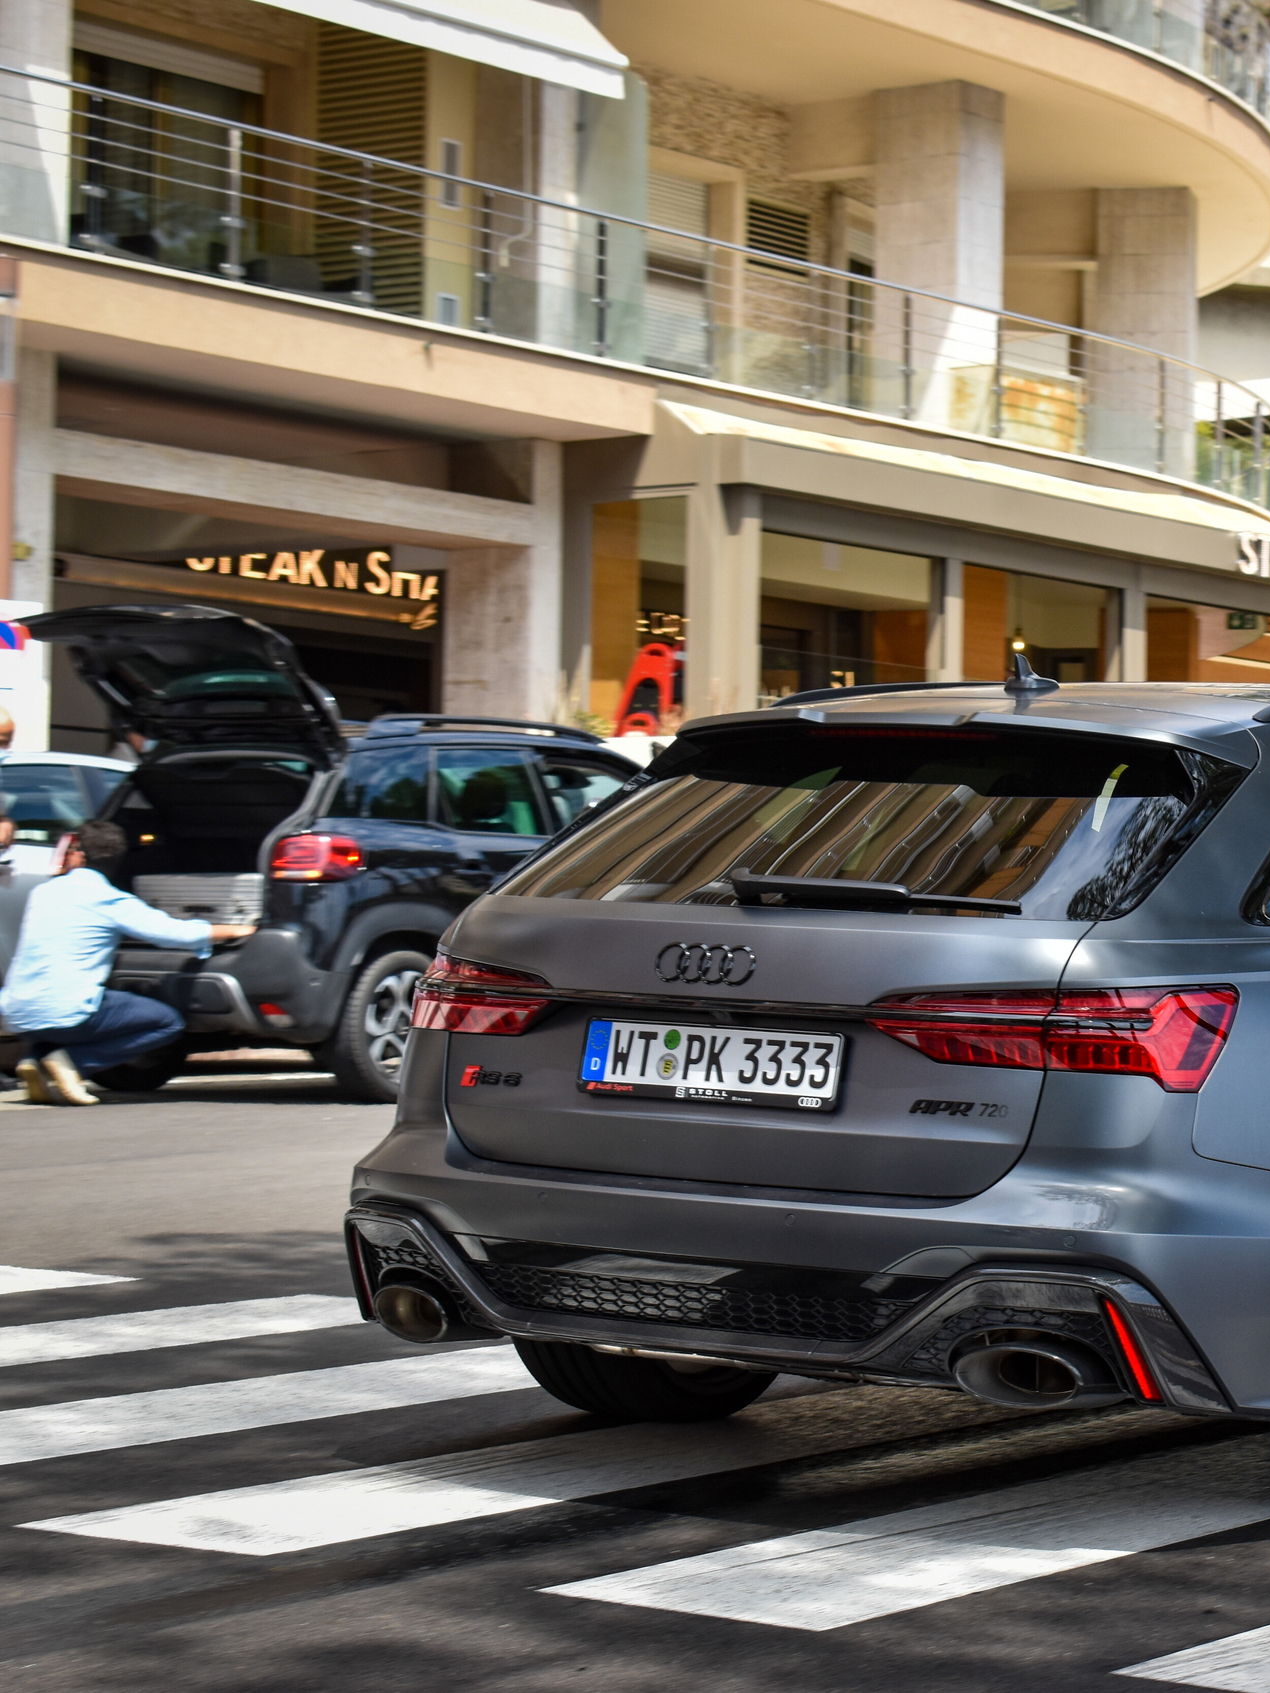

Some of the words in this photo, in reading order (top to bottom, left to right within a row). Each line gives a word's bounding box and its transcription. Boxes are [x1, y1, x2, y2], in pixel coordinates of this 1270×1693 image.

[333, 560, 359, 590] N
[590, 1057, 601, 1071] D
[611, 1029, 658, 1076] WT
[682, 1034, 731, 1083] PK
[738, 1038, 835, 1089] 3333
[613, 1083, 634, 1092] Sport
[689, 1088, 729, 1097] STOLL
[908, 1099, 975, 1117] APR
[979, 1103, 1009, 1118] 720
